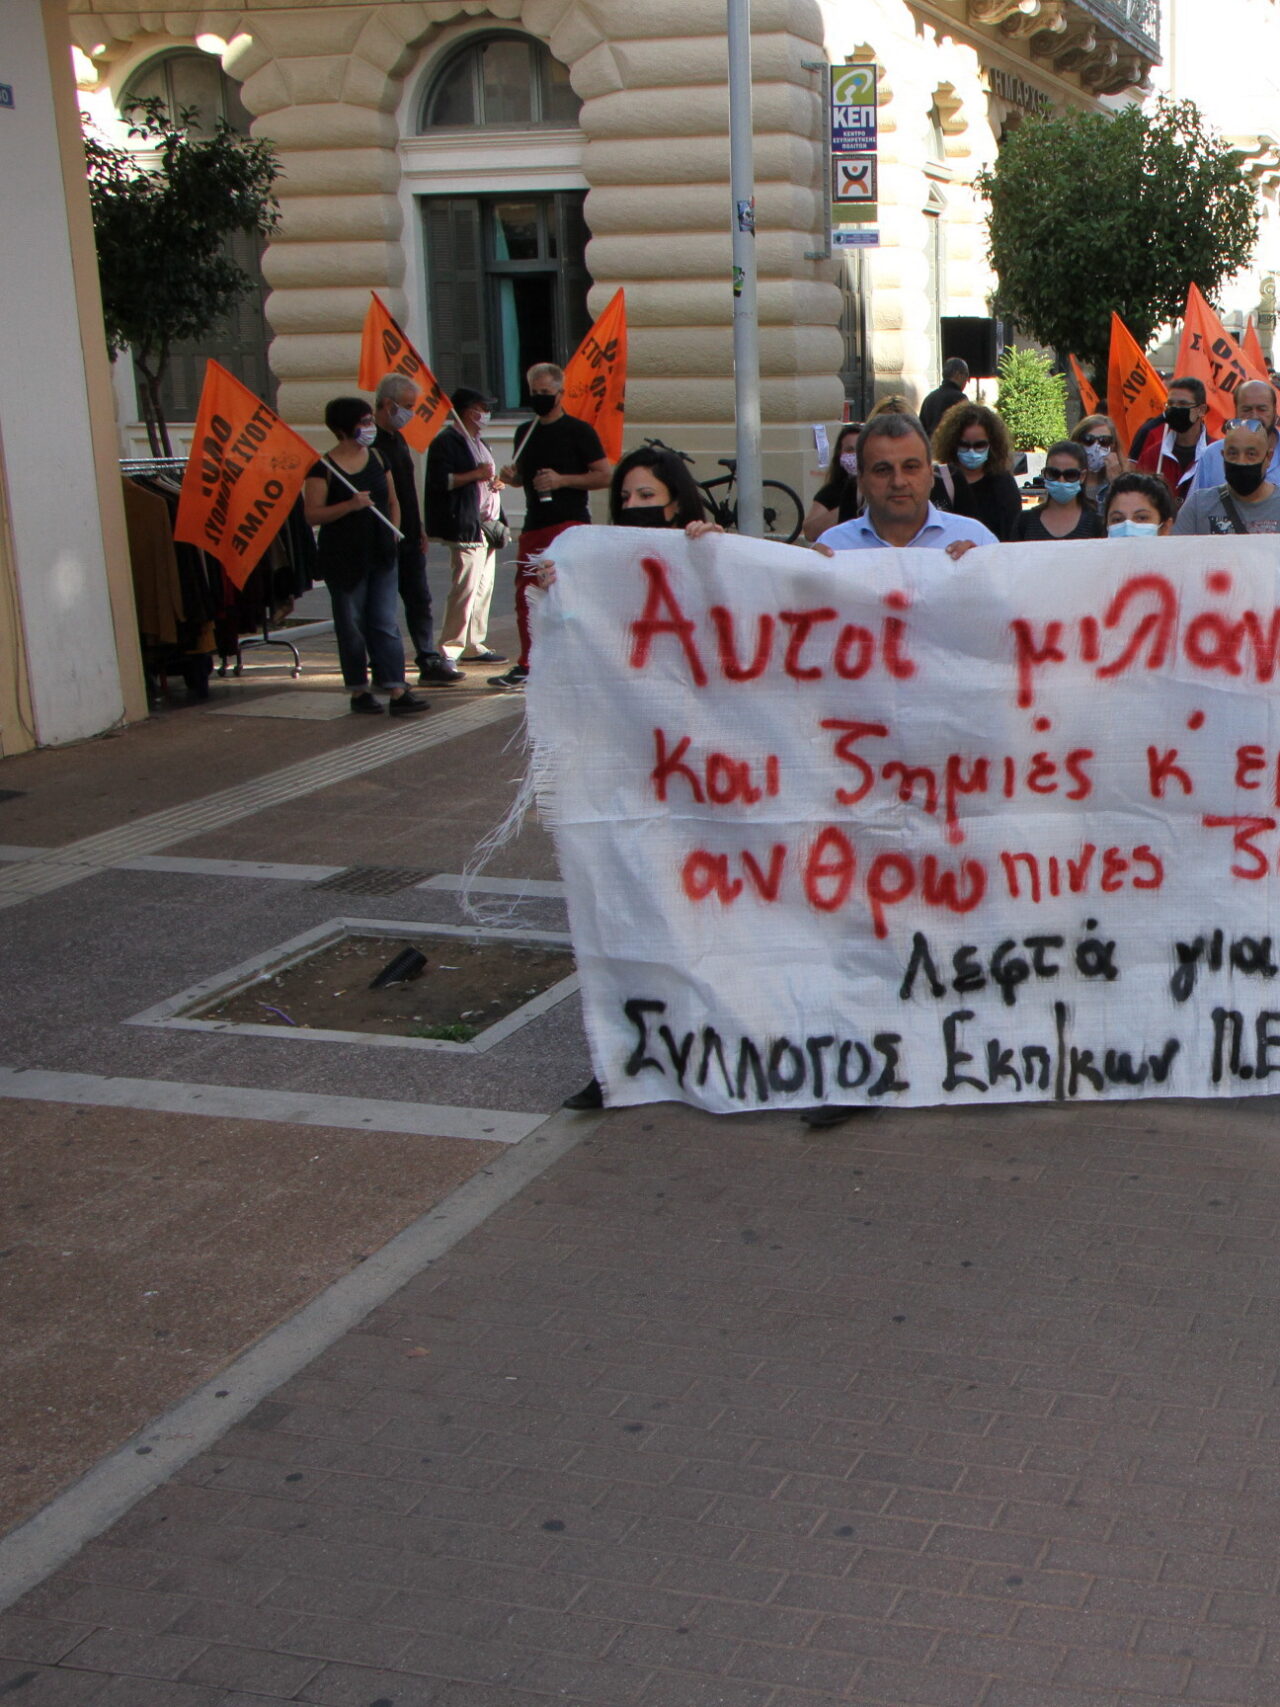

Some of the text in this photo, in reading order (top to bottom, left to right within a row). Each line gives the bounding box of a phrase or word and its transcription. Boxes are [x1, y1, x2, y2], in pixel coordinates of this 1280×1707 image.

[833, 106, 875, 129] ΚΕΠ
[630, 558, 915, 686] Αυτοί
[900, 919, 1118, 1004] Λεφτά
[1170, 929, 1278, 1002] για
